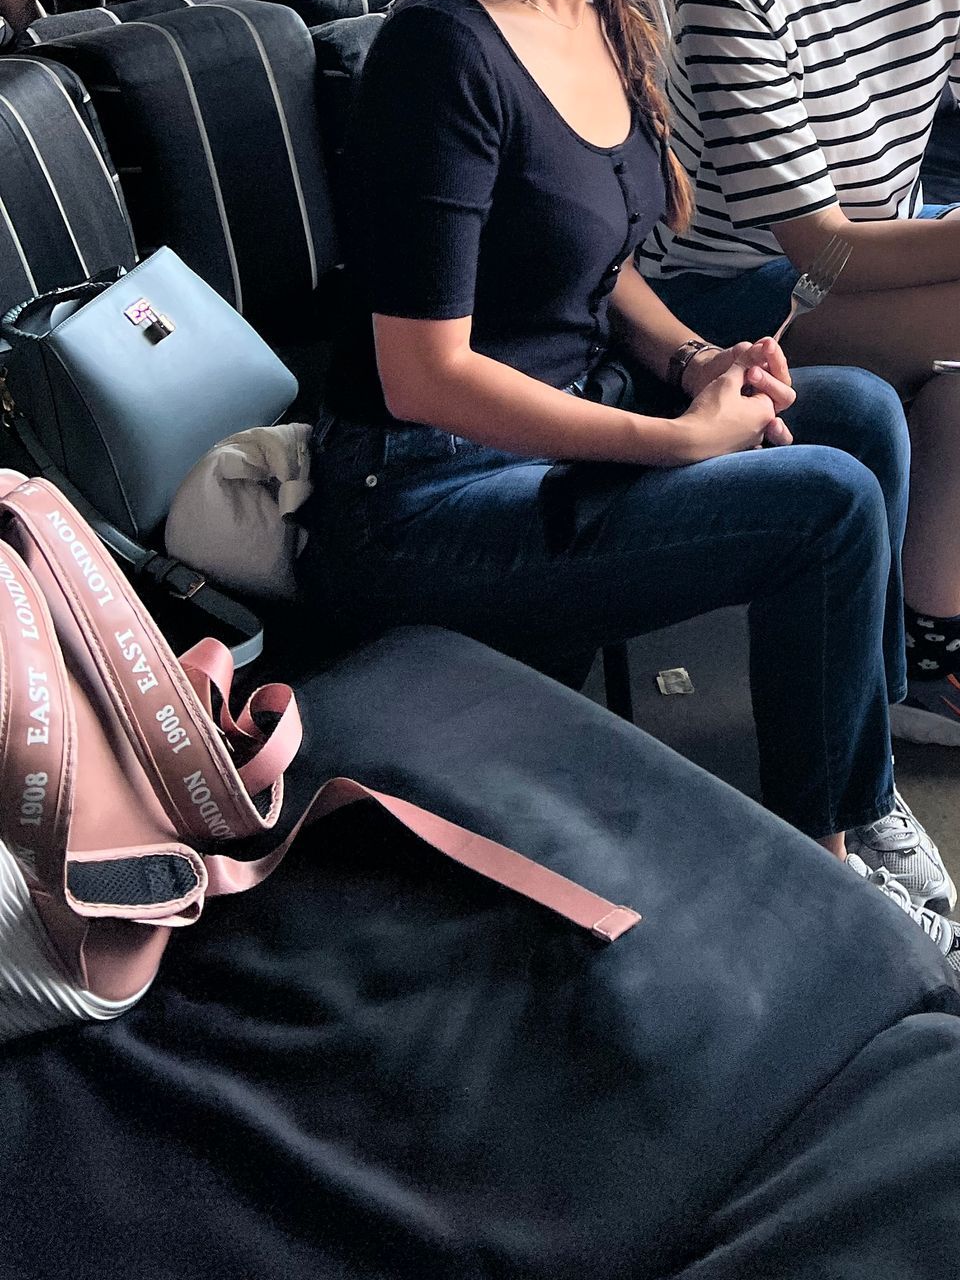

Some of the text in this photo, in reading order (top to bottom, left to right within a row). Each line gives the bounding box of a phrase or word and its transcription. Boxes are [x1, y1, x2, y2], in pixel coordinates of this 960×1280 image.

[46, 510, 115, 608] LONDON
[0, 560, 40, 641] LONDO
[114, 628, 159, 695] EAST
[27, 666, 51, 747] EAST
[155, 704, 192, 754] 1908
[20, 771, 48, 827] 1908
